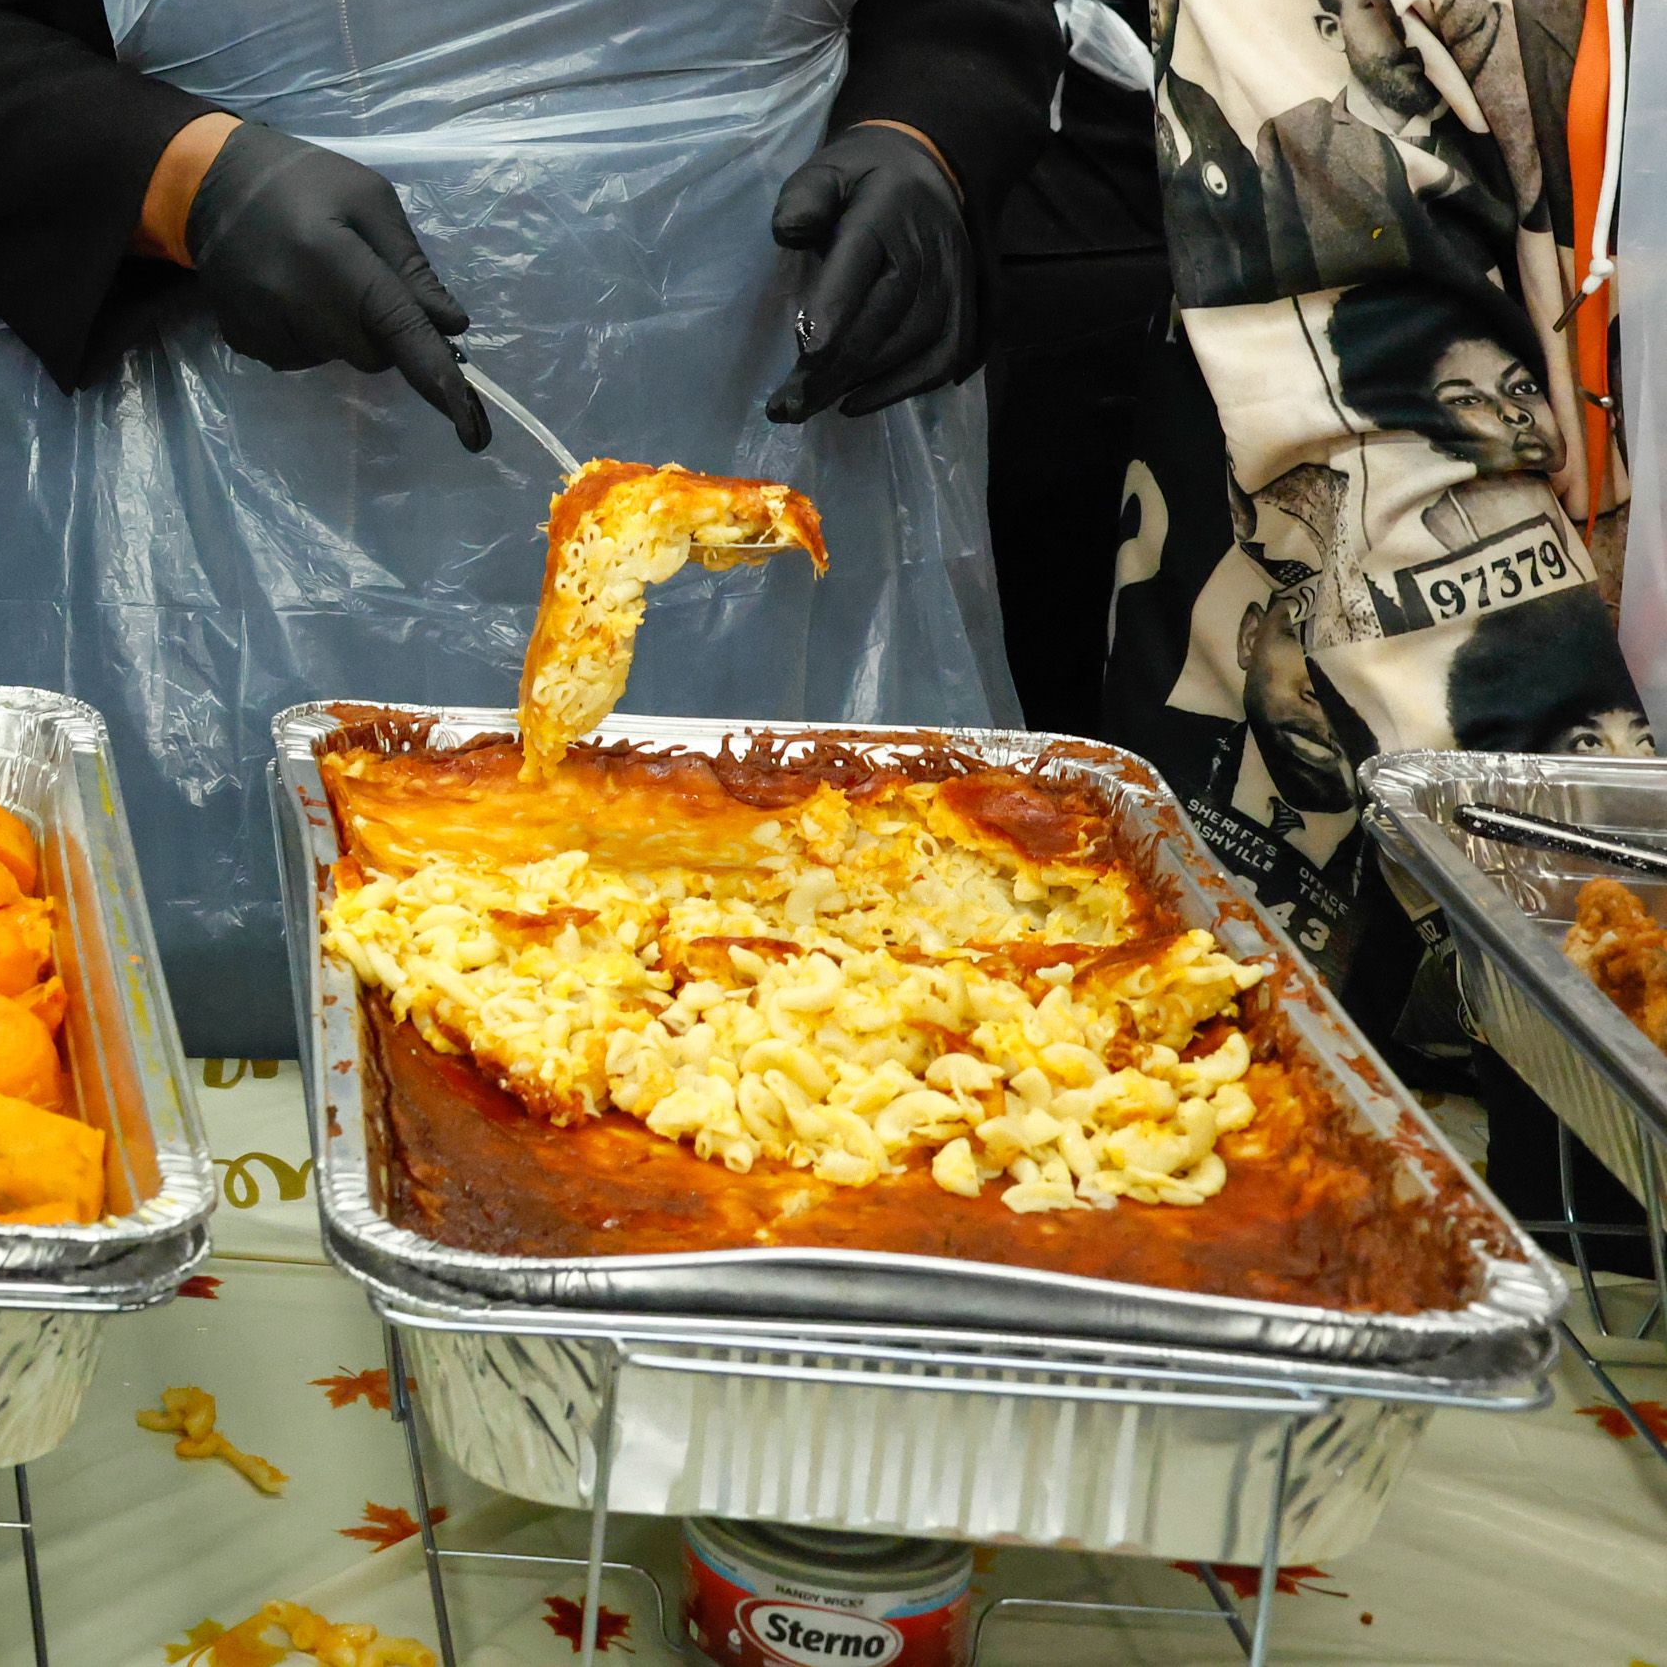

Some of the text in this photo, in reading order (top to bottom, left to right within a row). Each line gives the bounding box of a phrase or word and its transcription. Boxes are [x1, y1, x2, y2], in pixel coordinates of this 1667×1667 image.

[1429, 539, 1567, 620] 97379
[1192, 820, 1275, 872] ASHVILLE
[774, 1583, 820, 1604] HANDY
[765, 1612, 886, 1659] Sterno
